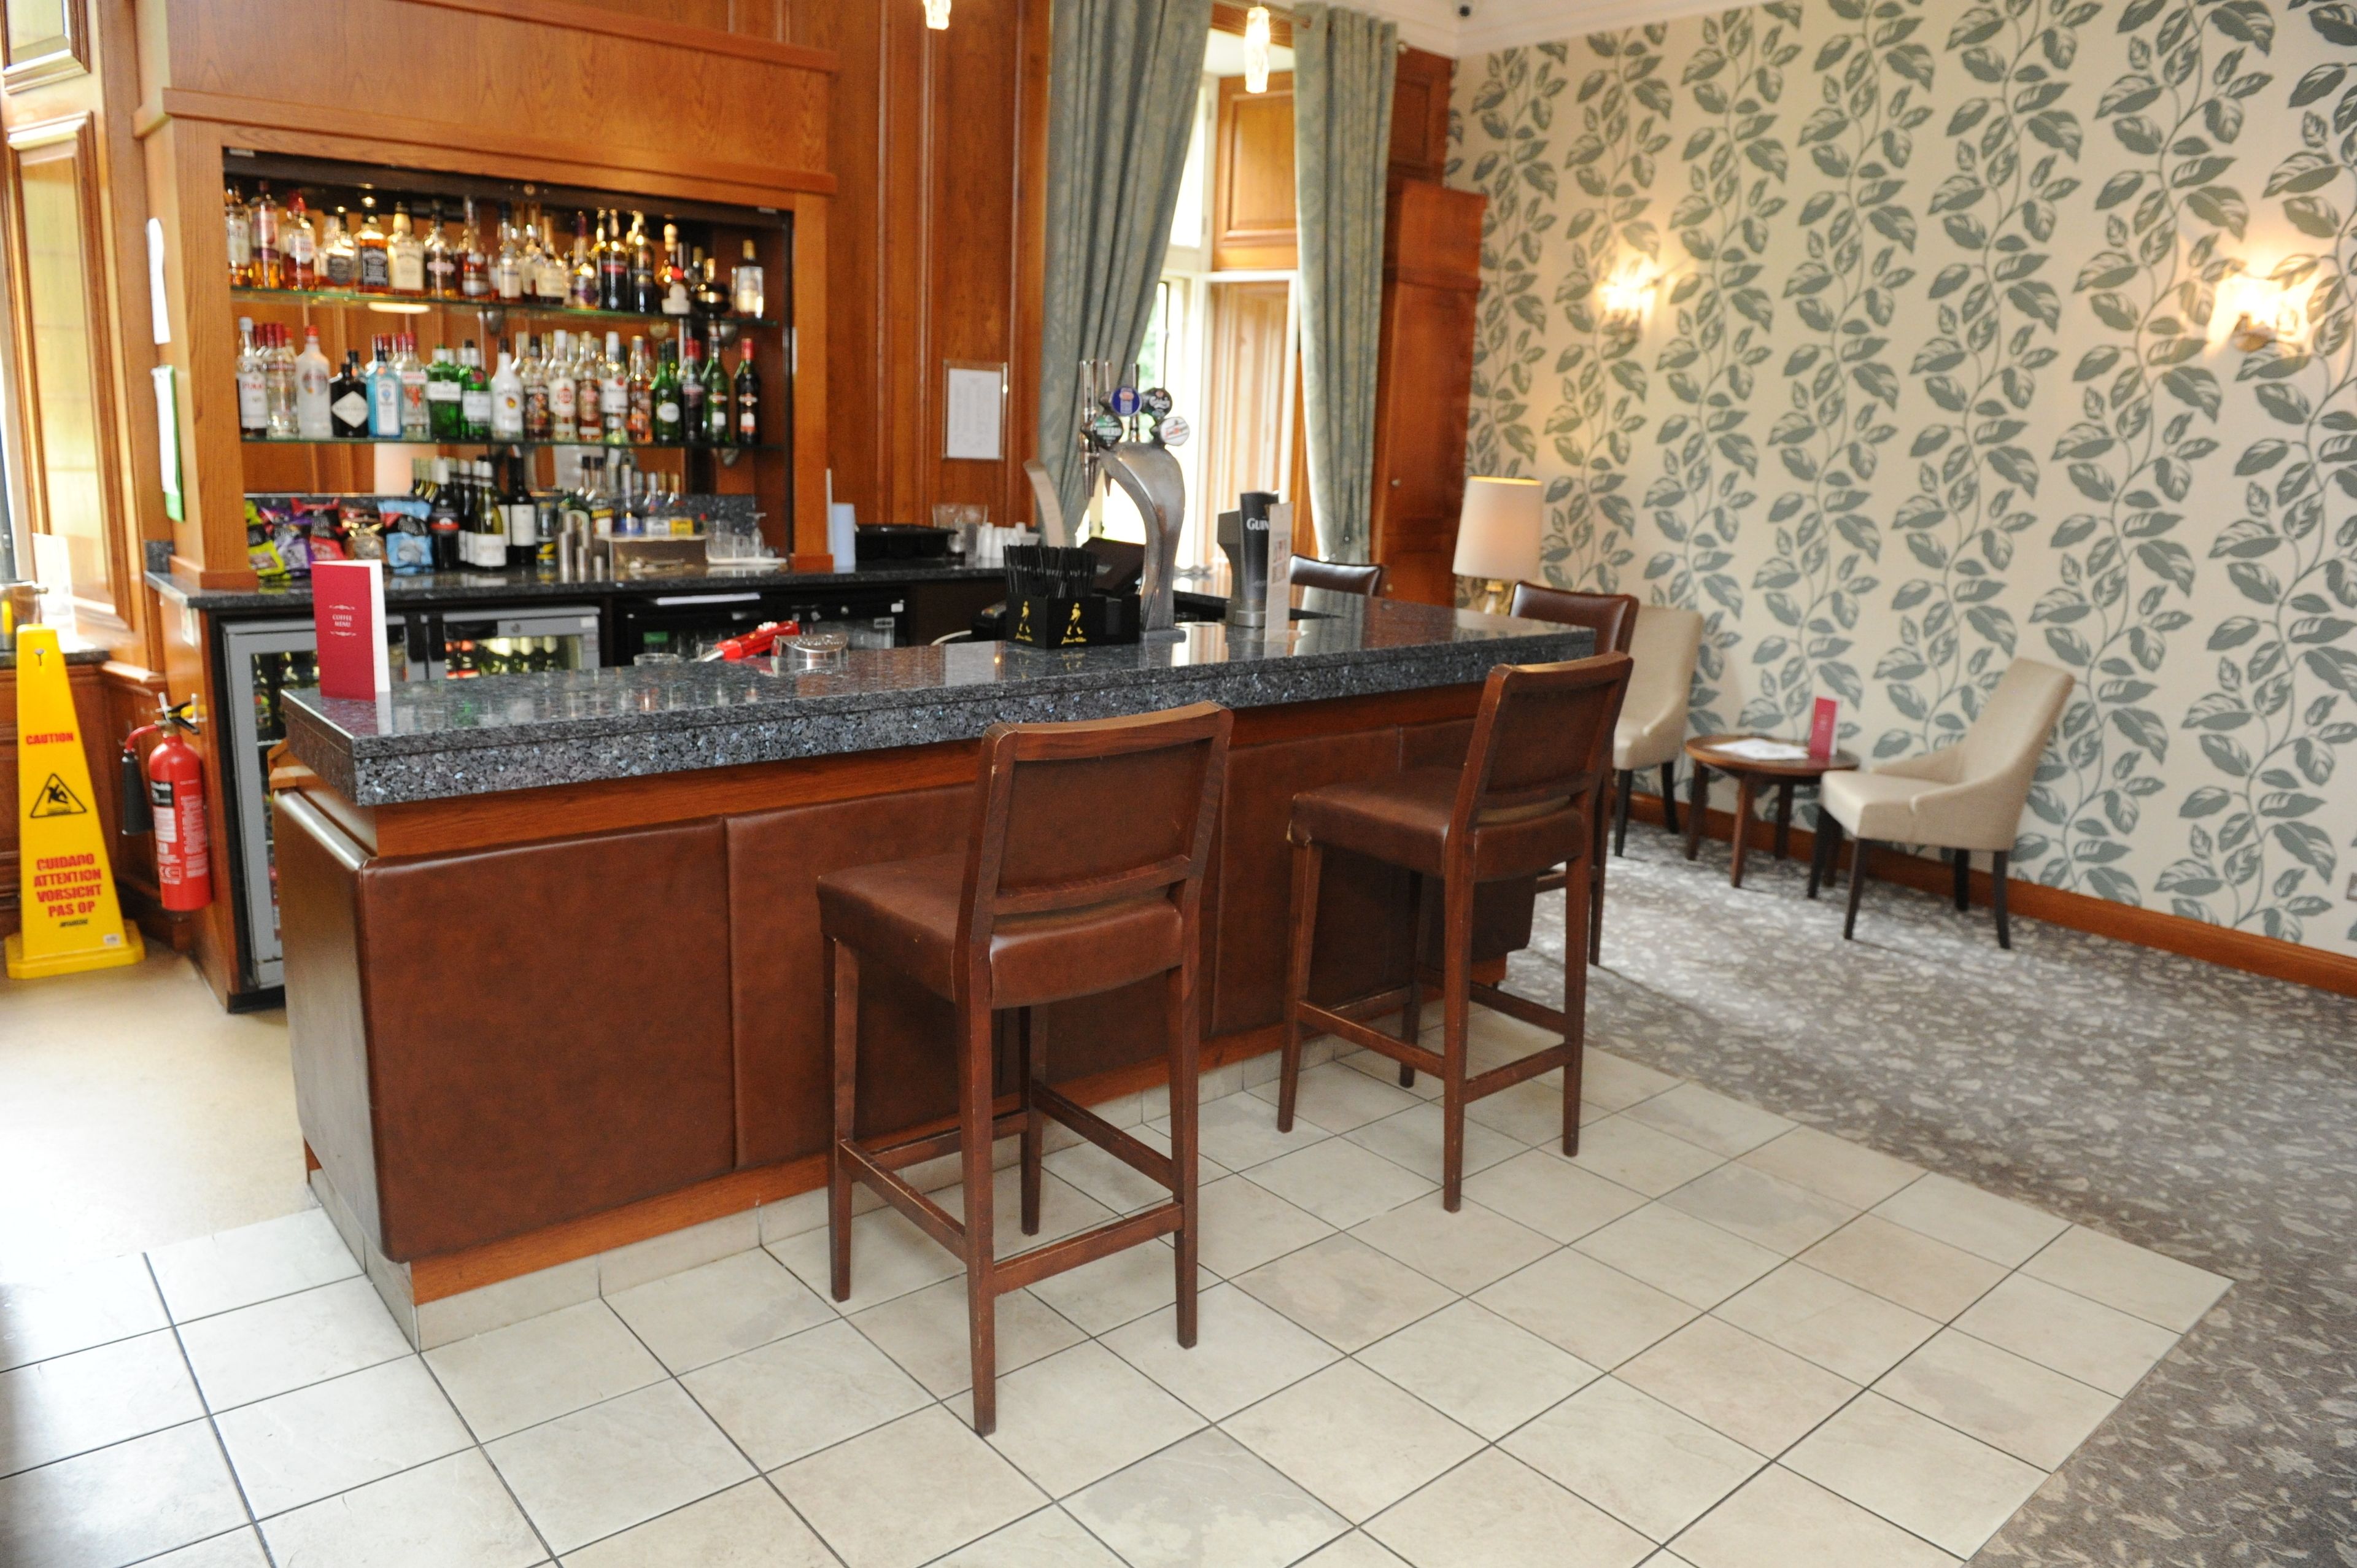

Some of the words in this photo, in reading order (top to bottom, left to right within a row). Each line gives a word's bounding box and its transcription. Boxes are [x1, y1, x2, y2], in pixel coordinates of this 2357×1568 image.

[1247, 517, 1269, 531] GUIN
[26, 732, 74, 745] CAUTION
[37, 853, 95, 871] CUIDADO
[34, 868, 101, 887] ATTENTION
[36, 884, 101, 903] VORSICHT
[48, 903, 74, 917] PAS
[78, 900, 95, 914] OP
